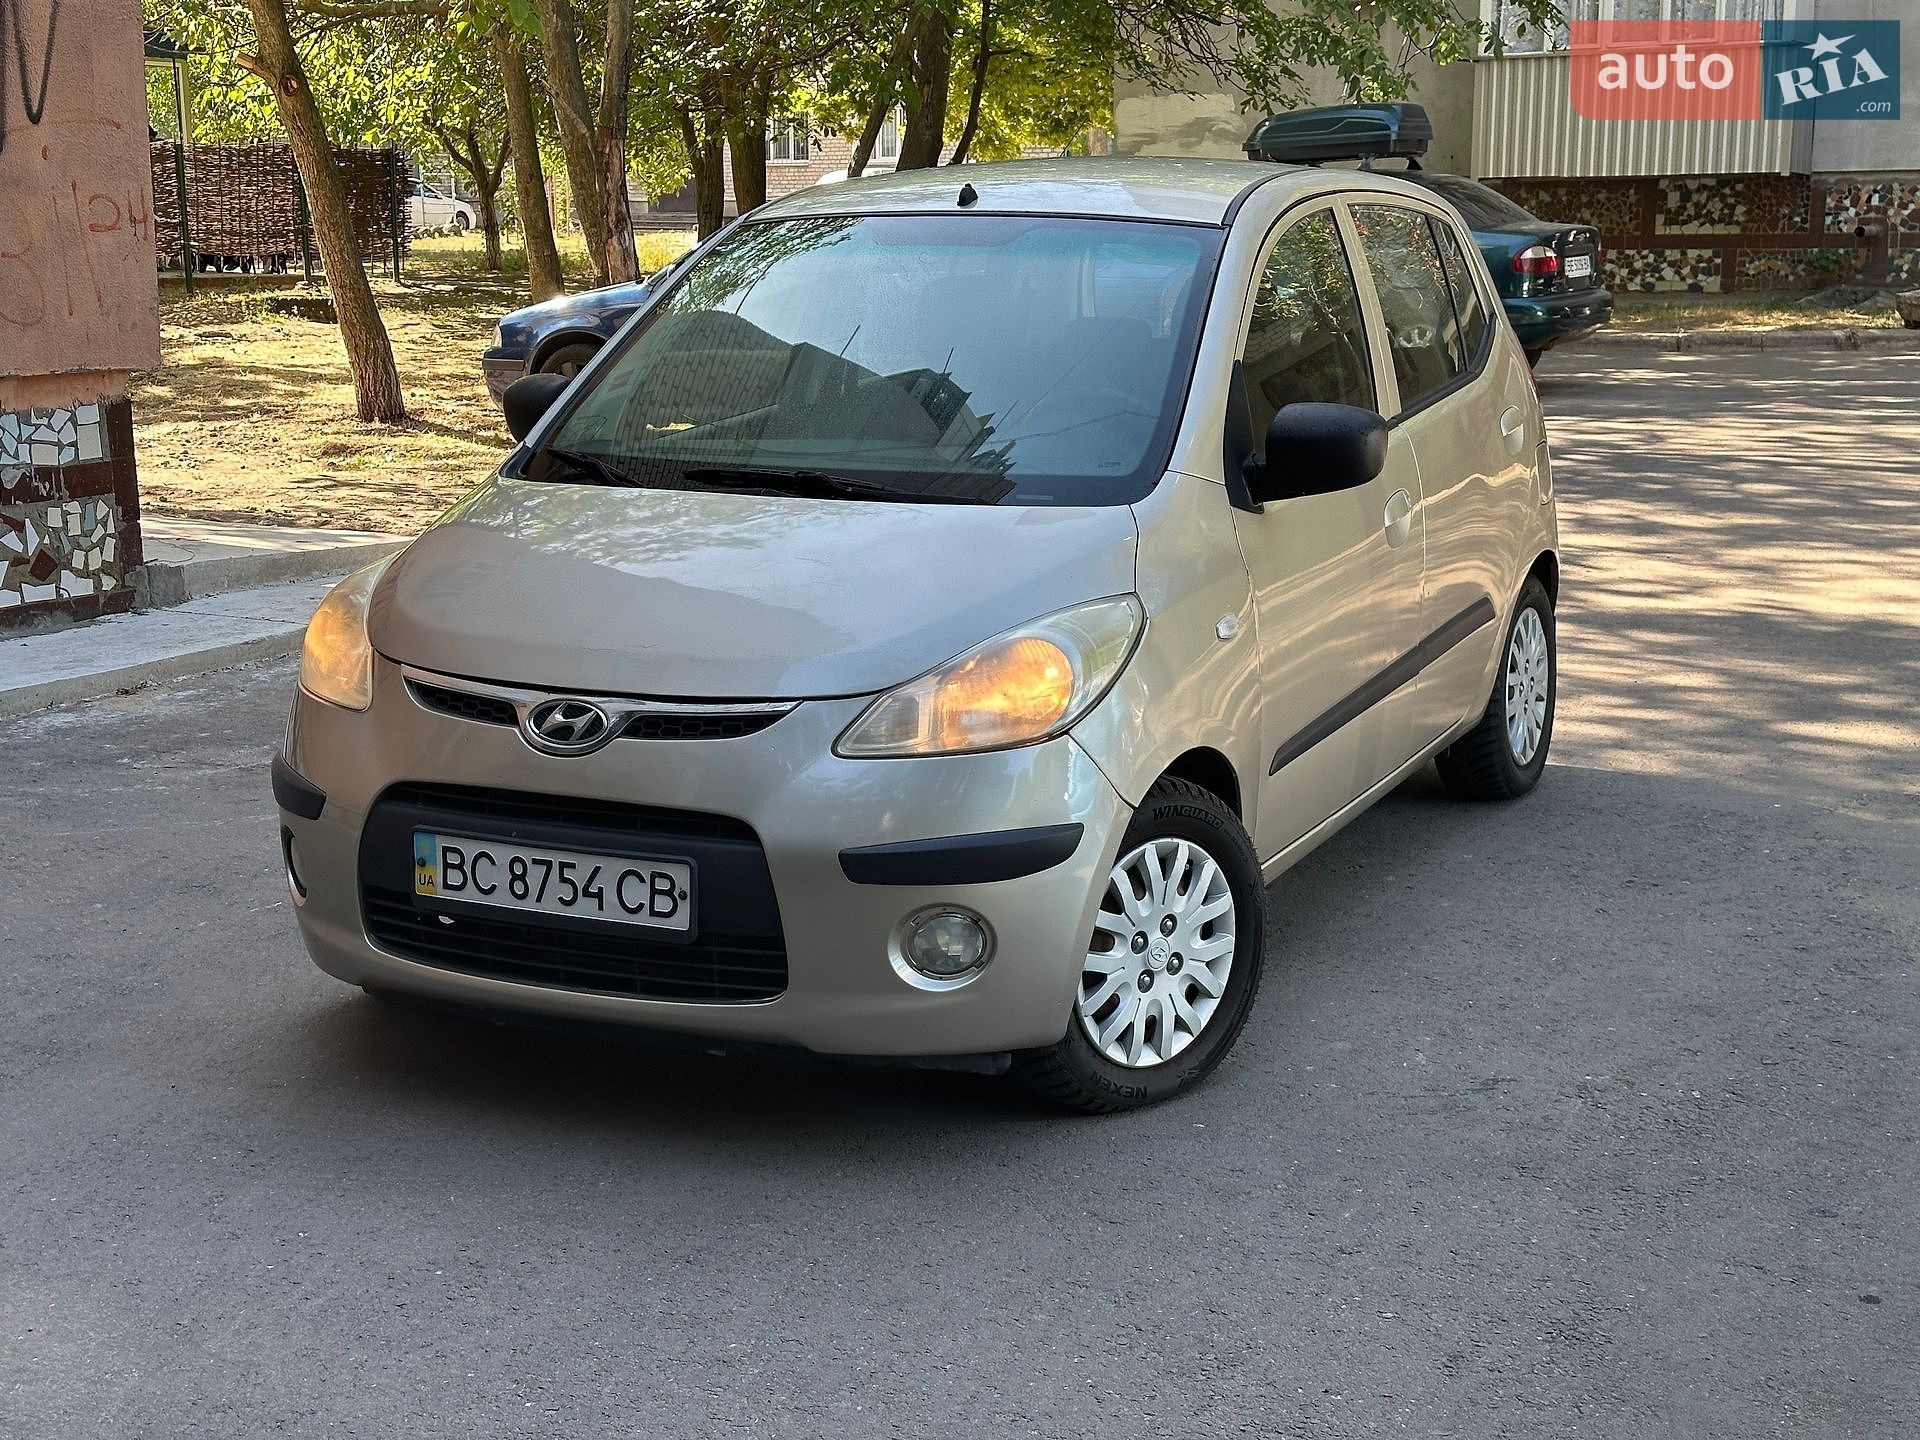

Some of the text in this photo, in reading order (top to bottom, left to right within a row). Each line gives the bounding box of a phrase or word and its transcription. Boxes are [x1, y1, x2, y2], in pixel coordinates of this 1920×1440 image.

[1152, 804, 1224, 830] WINGUARD
[418, 873, 435, 888] UA
[441, 845, 679, 919] BC 8754 CB
[1090, 1070, 1148, 1098] NEXEN
